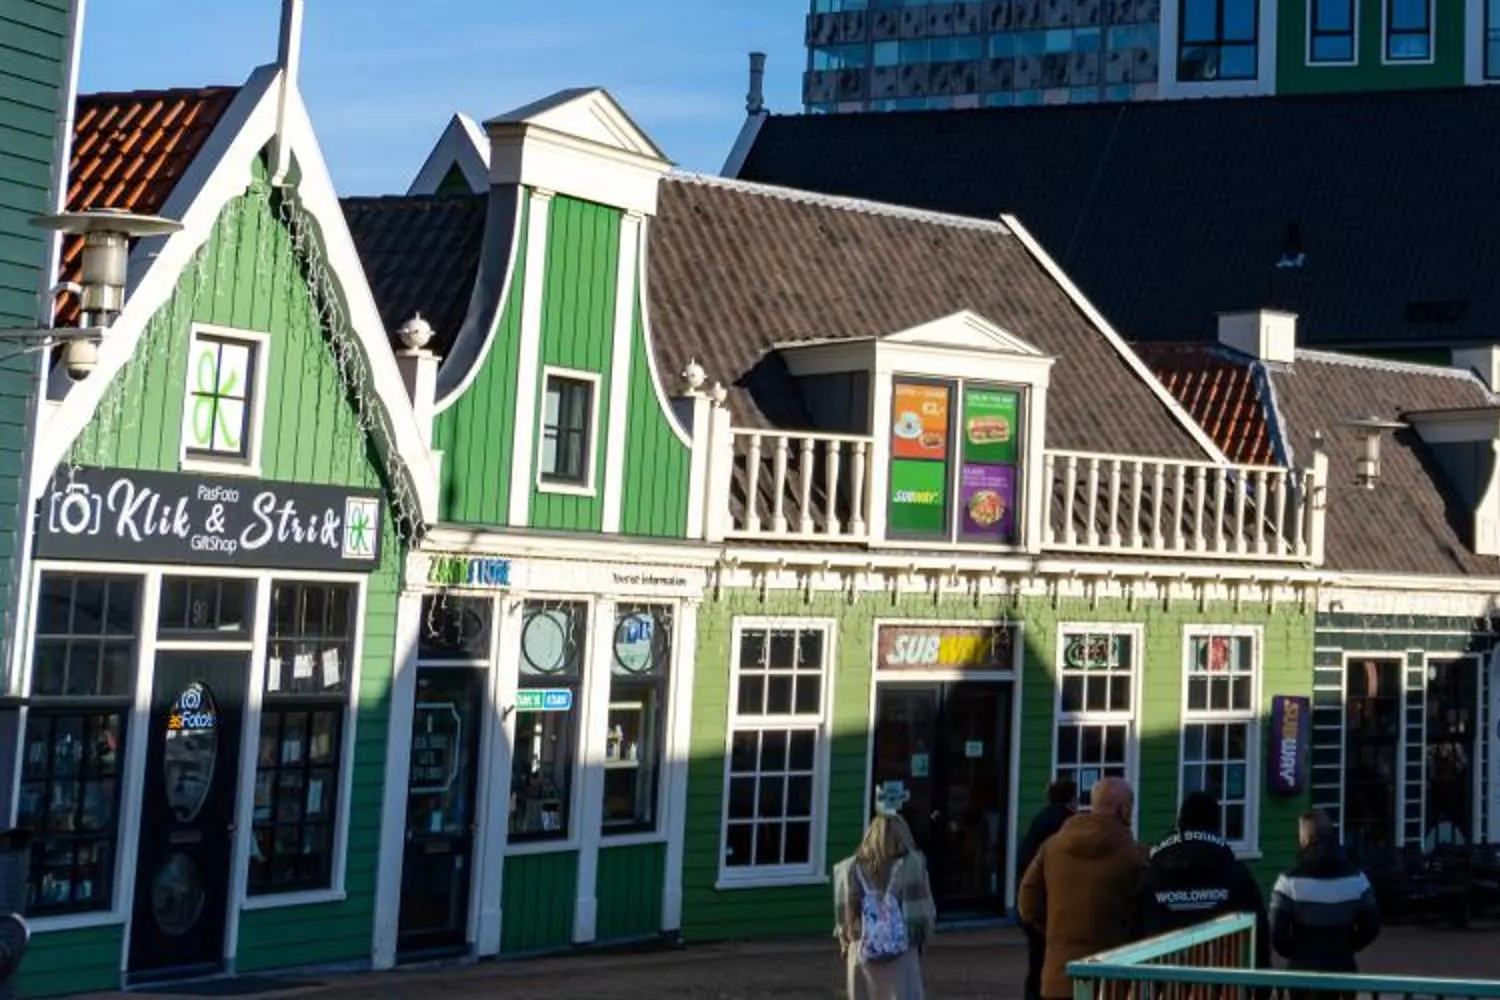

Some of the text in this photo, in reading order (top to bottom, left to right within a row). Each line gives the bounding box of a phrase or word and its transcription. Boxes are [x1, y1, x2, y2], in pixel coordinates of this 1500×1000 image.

[106, 477, 191, 542] Klik
[205, 502, 226, 533] &
[886, 634, 994, 665] SUBWAY
[1280, 699, 1299, 788] SUBWAY
